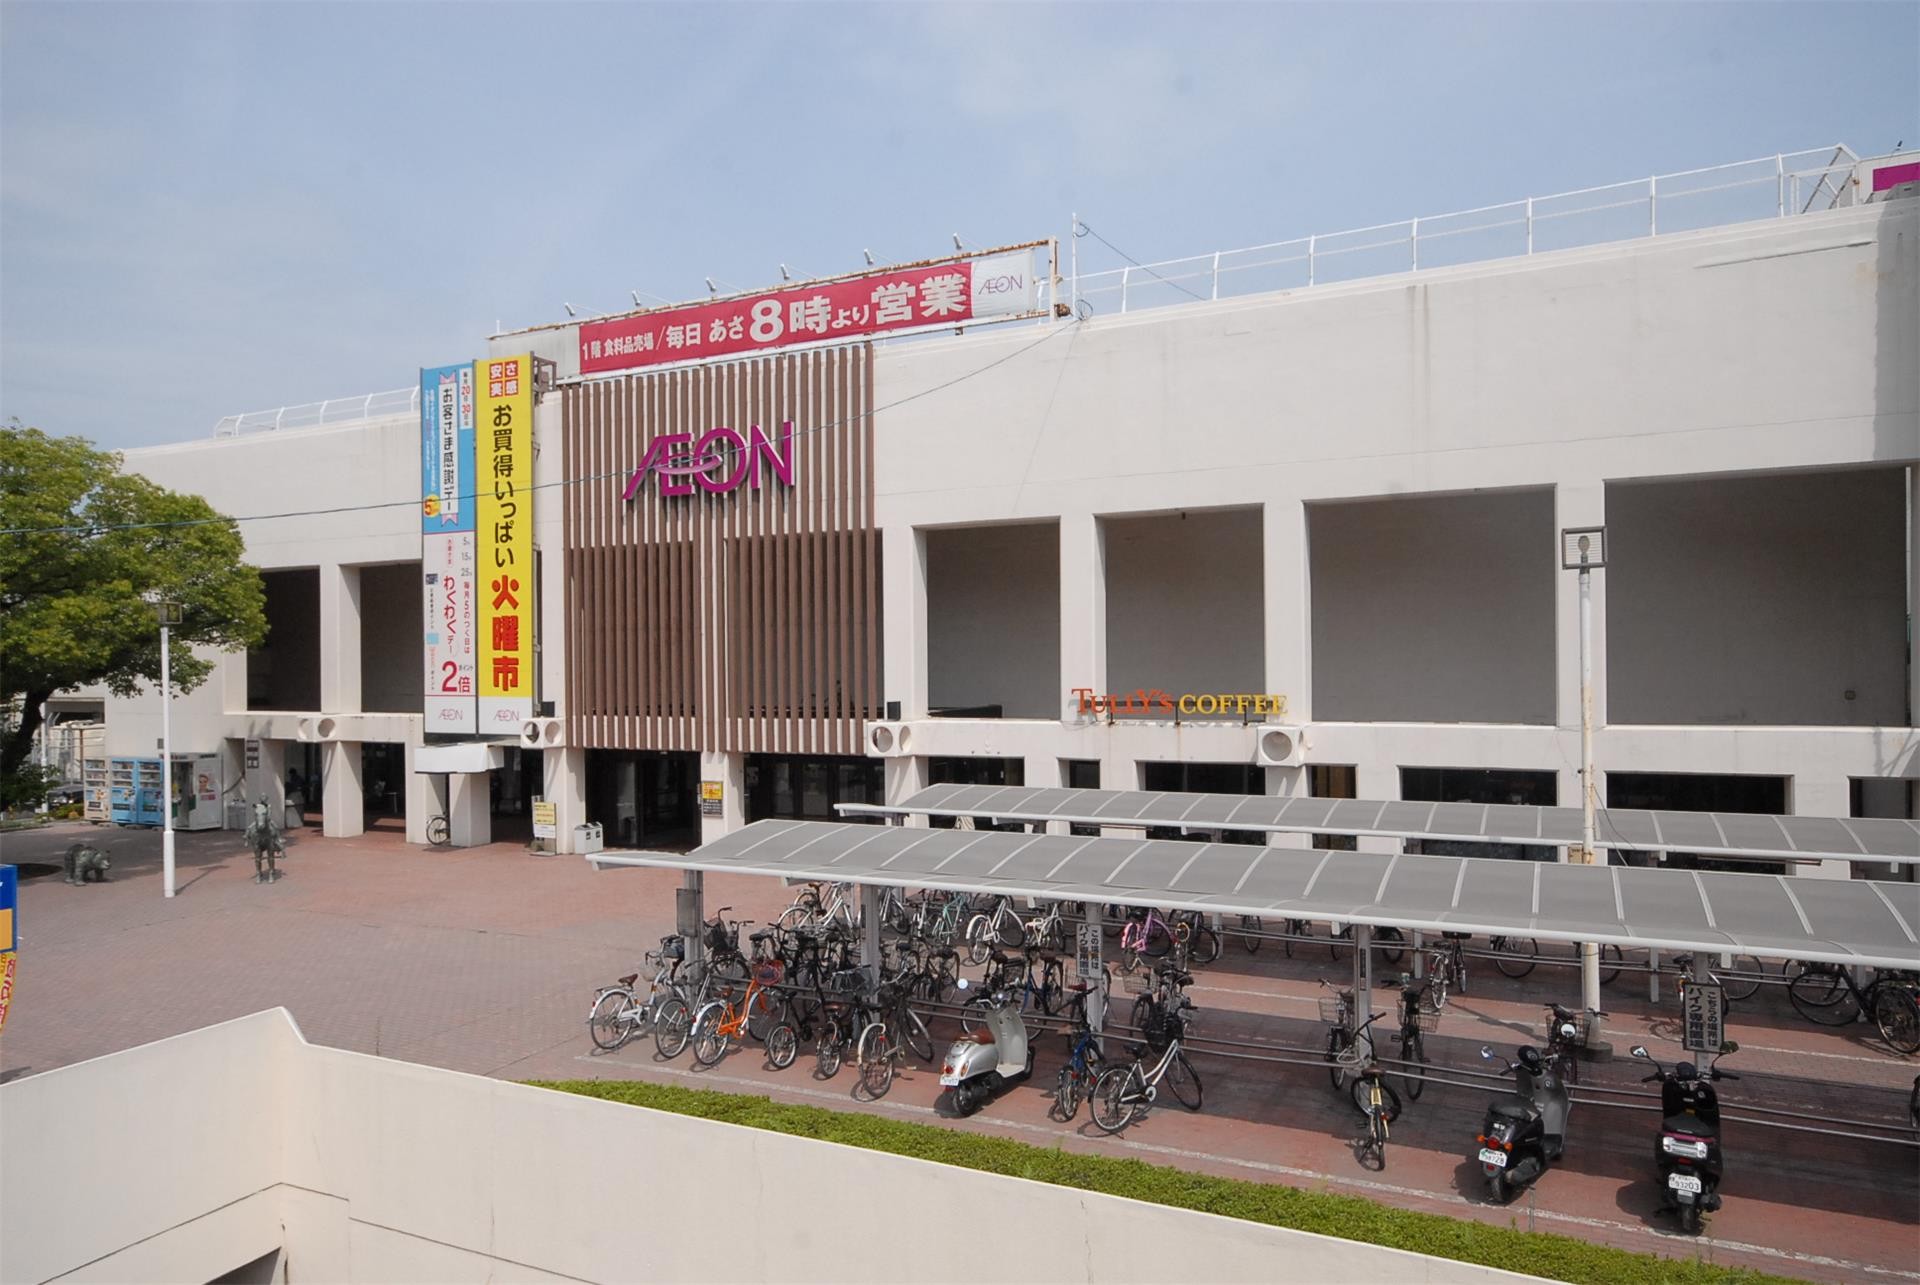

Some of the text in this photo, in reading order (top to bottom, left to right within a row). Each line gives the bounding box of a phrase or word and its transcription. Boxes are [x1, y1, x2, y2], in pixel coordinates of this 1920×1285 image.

[491, 575, 520, 692] 火曜市
[1179, 693, 1288, 715] COFFEE
